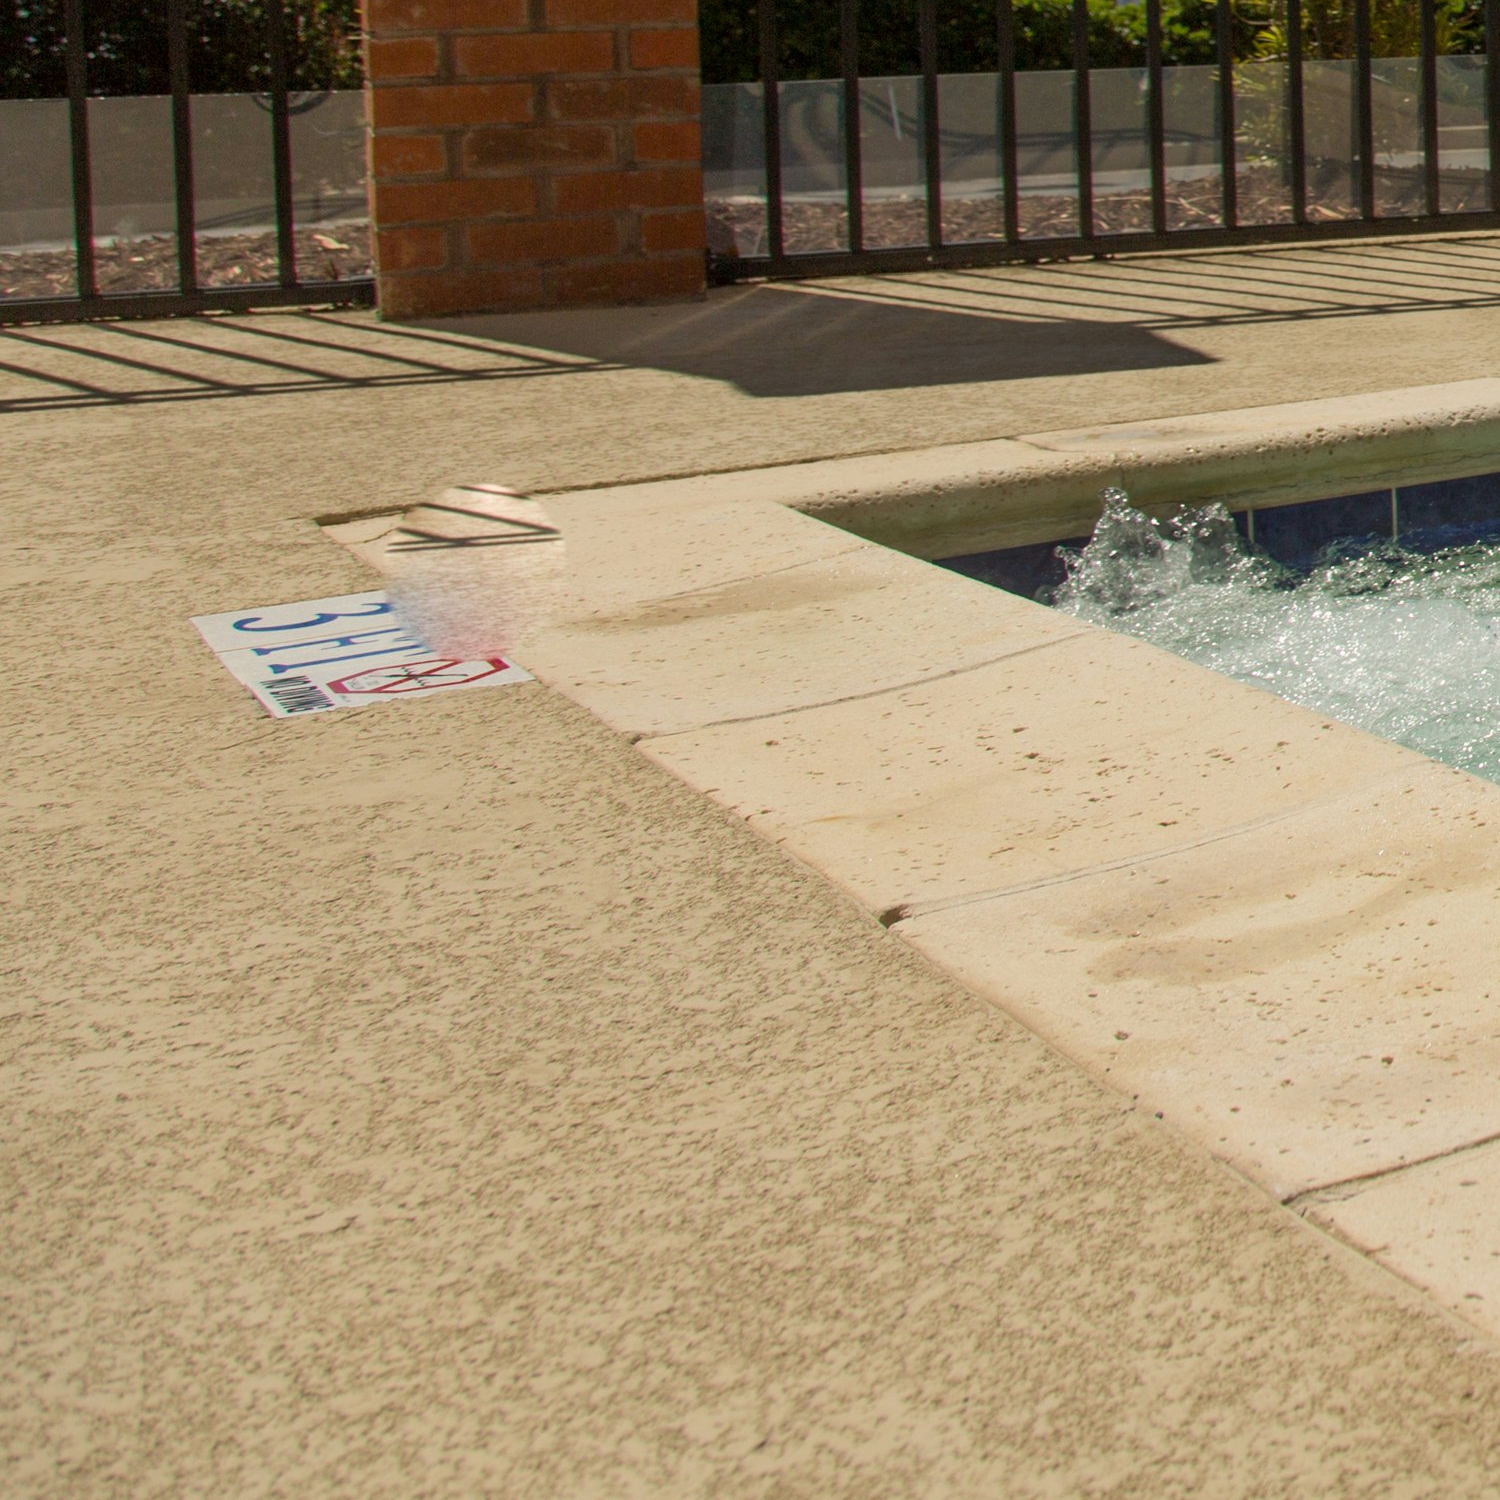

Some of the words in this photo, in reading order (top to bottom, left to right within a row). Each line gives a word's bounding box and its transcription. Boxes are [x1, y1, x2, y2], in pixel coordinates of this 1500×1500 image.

[232, 602, 394, 632] 3
[259, 675, 312, 689] NO
[268, 685, 335, 713] DIVING
